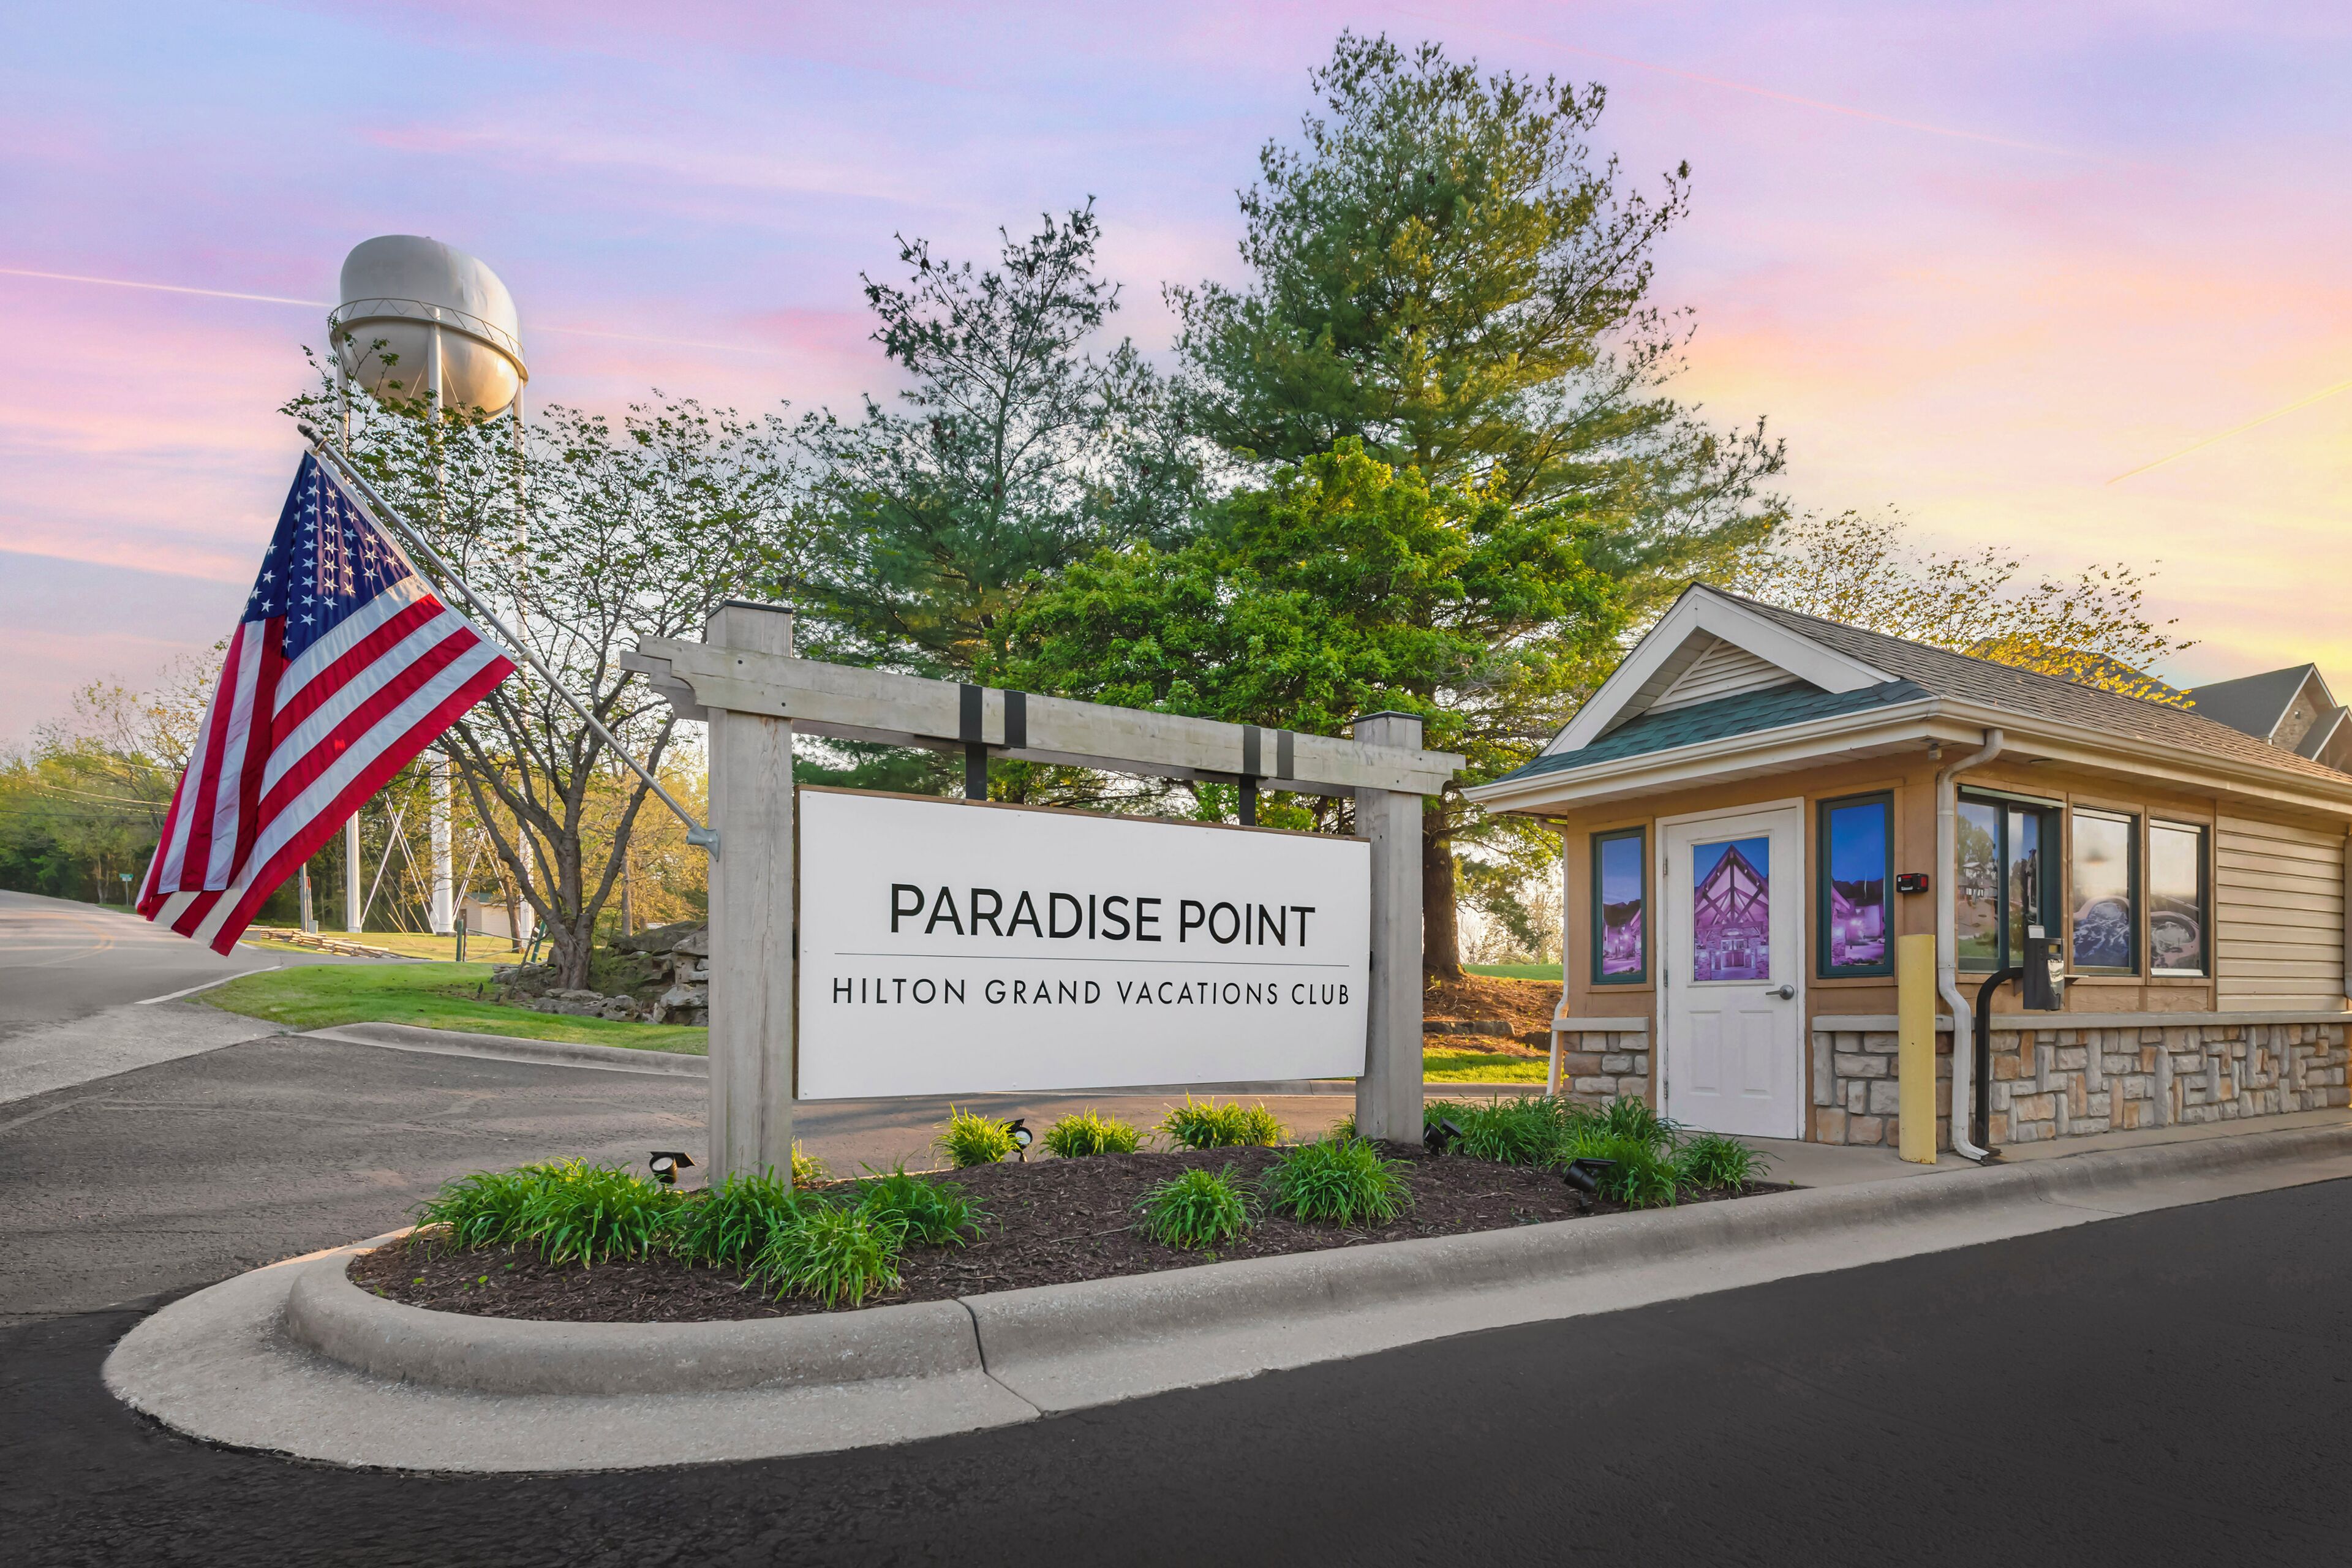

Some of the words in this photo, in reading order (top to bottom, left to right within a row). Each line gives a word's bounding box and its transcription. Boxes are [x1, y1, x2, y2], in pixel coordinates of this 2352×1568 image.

[891, 883, 1161, 942] PARADISE
[1180, 899, 1316, 947] POINT
[833, 977, 965, 1005] HILTON
[985, 979, 1101, 1005] GRAND
[1117, 981, 1278, 1005] VACATIONS
[1291, 983, 1349, 1005] CLUB
